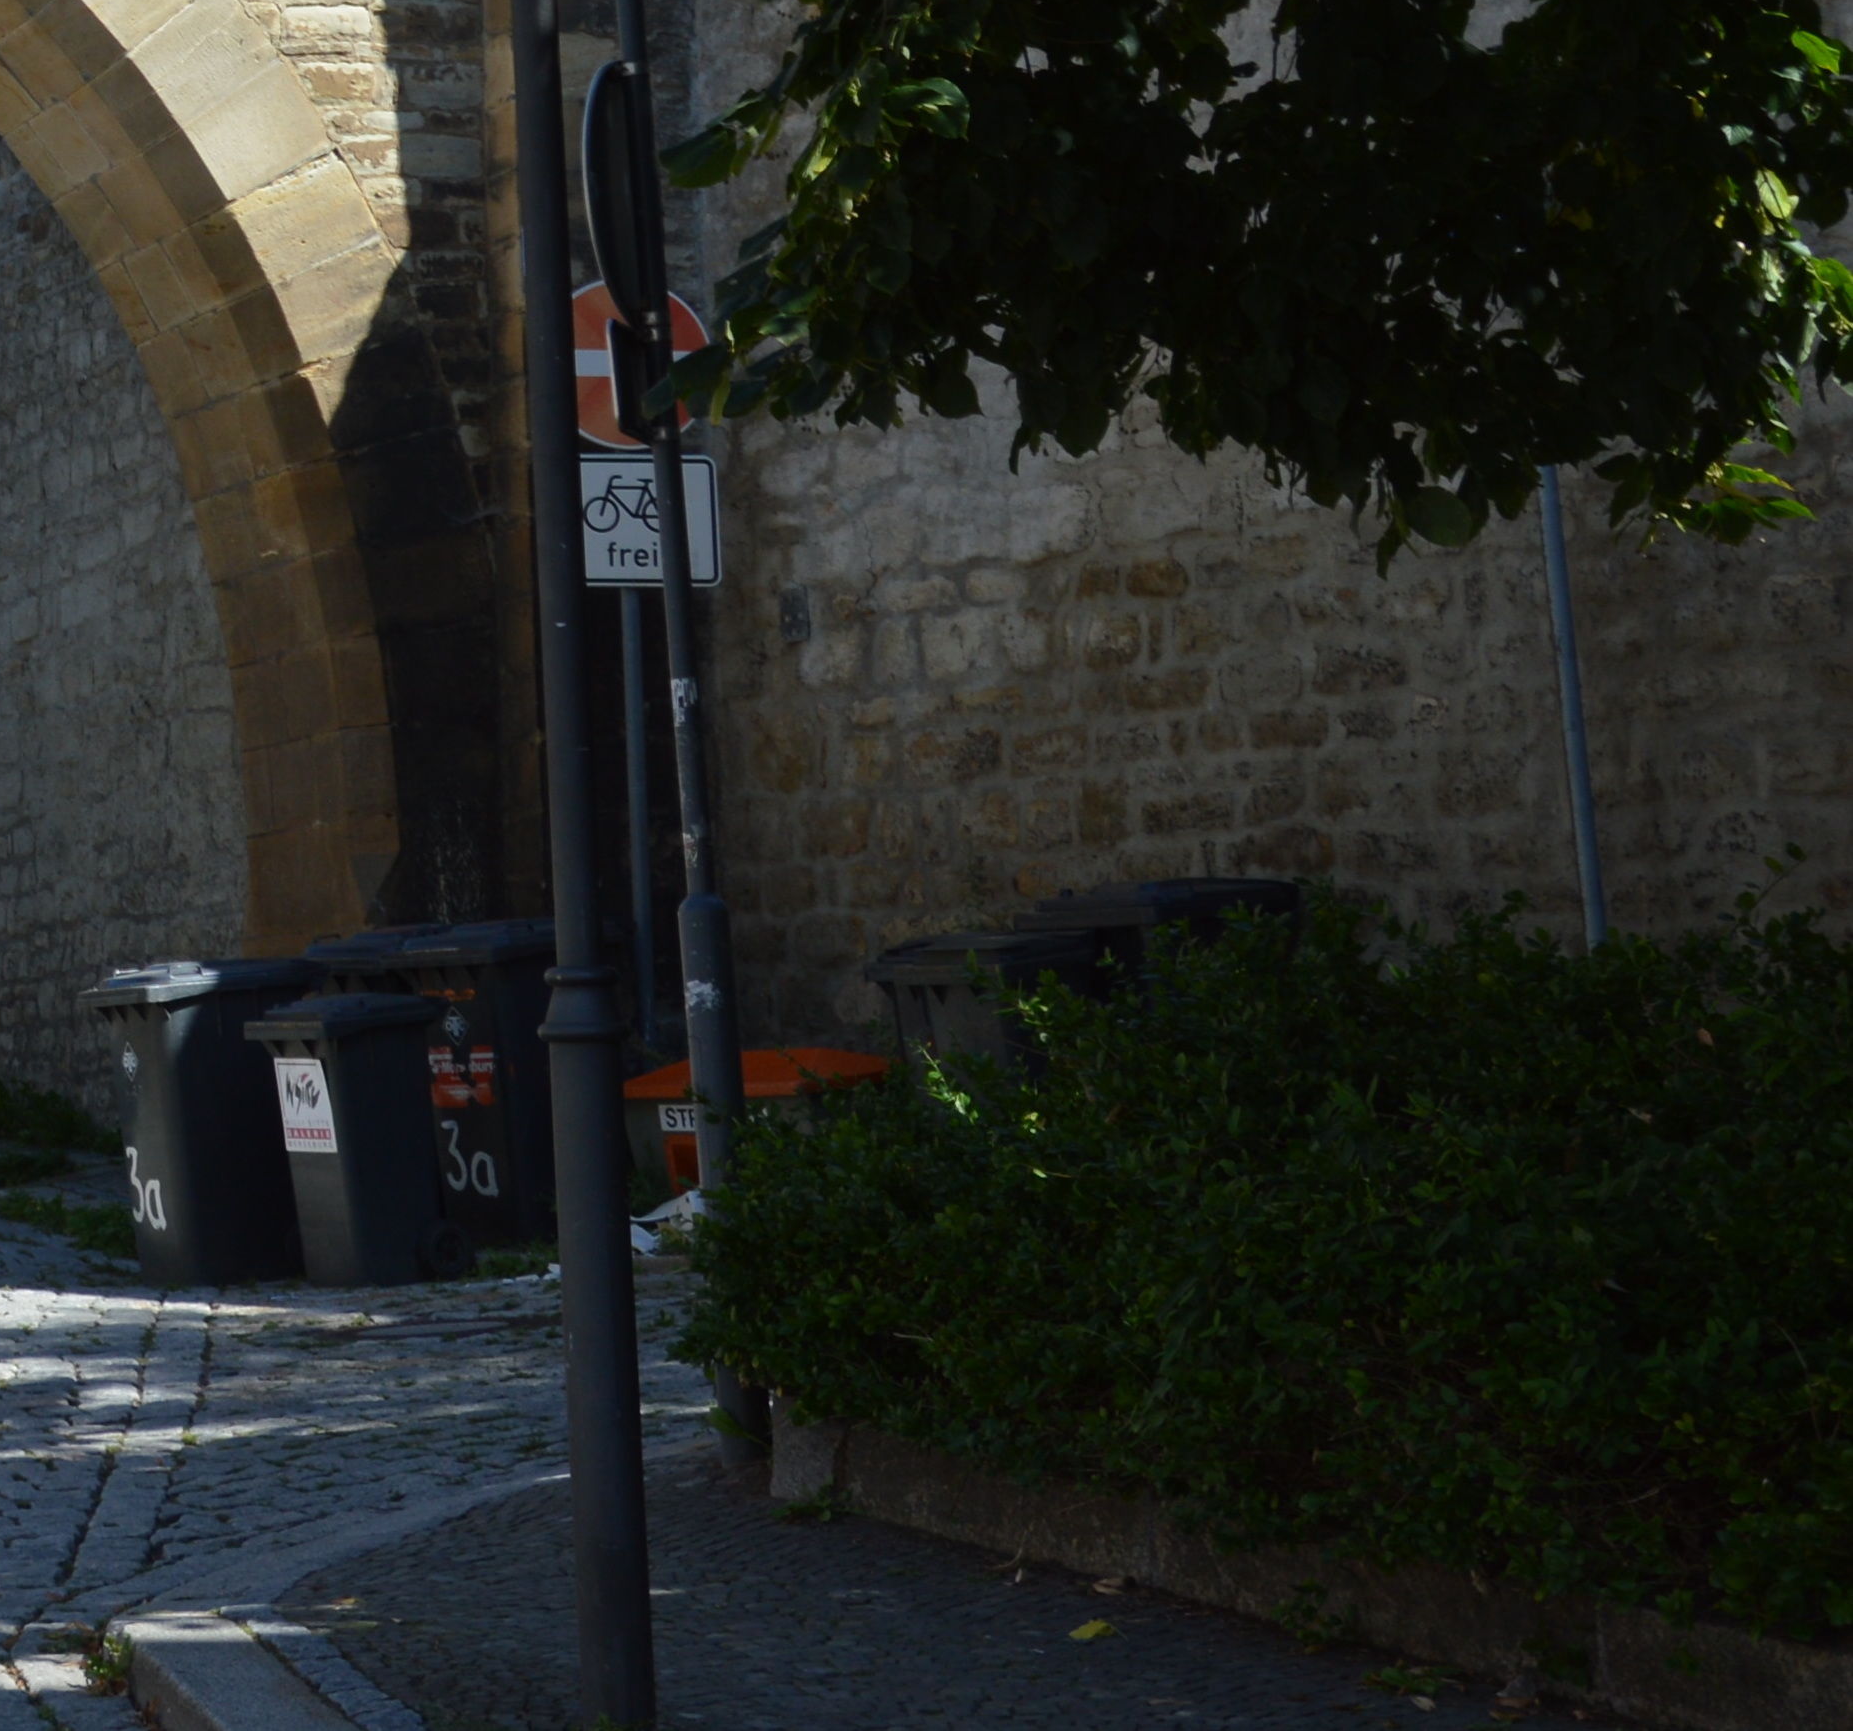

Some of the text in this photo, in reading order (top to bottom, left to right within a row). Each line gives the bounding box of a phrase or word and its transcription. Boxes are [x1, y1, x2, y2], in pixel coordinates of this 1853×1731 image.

[607, 541, 658, 567] frei
[125, 1146, 166, 1231] 3a
[440, 1119, 499, 1198] 3a
